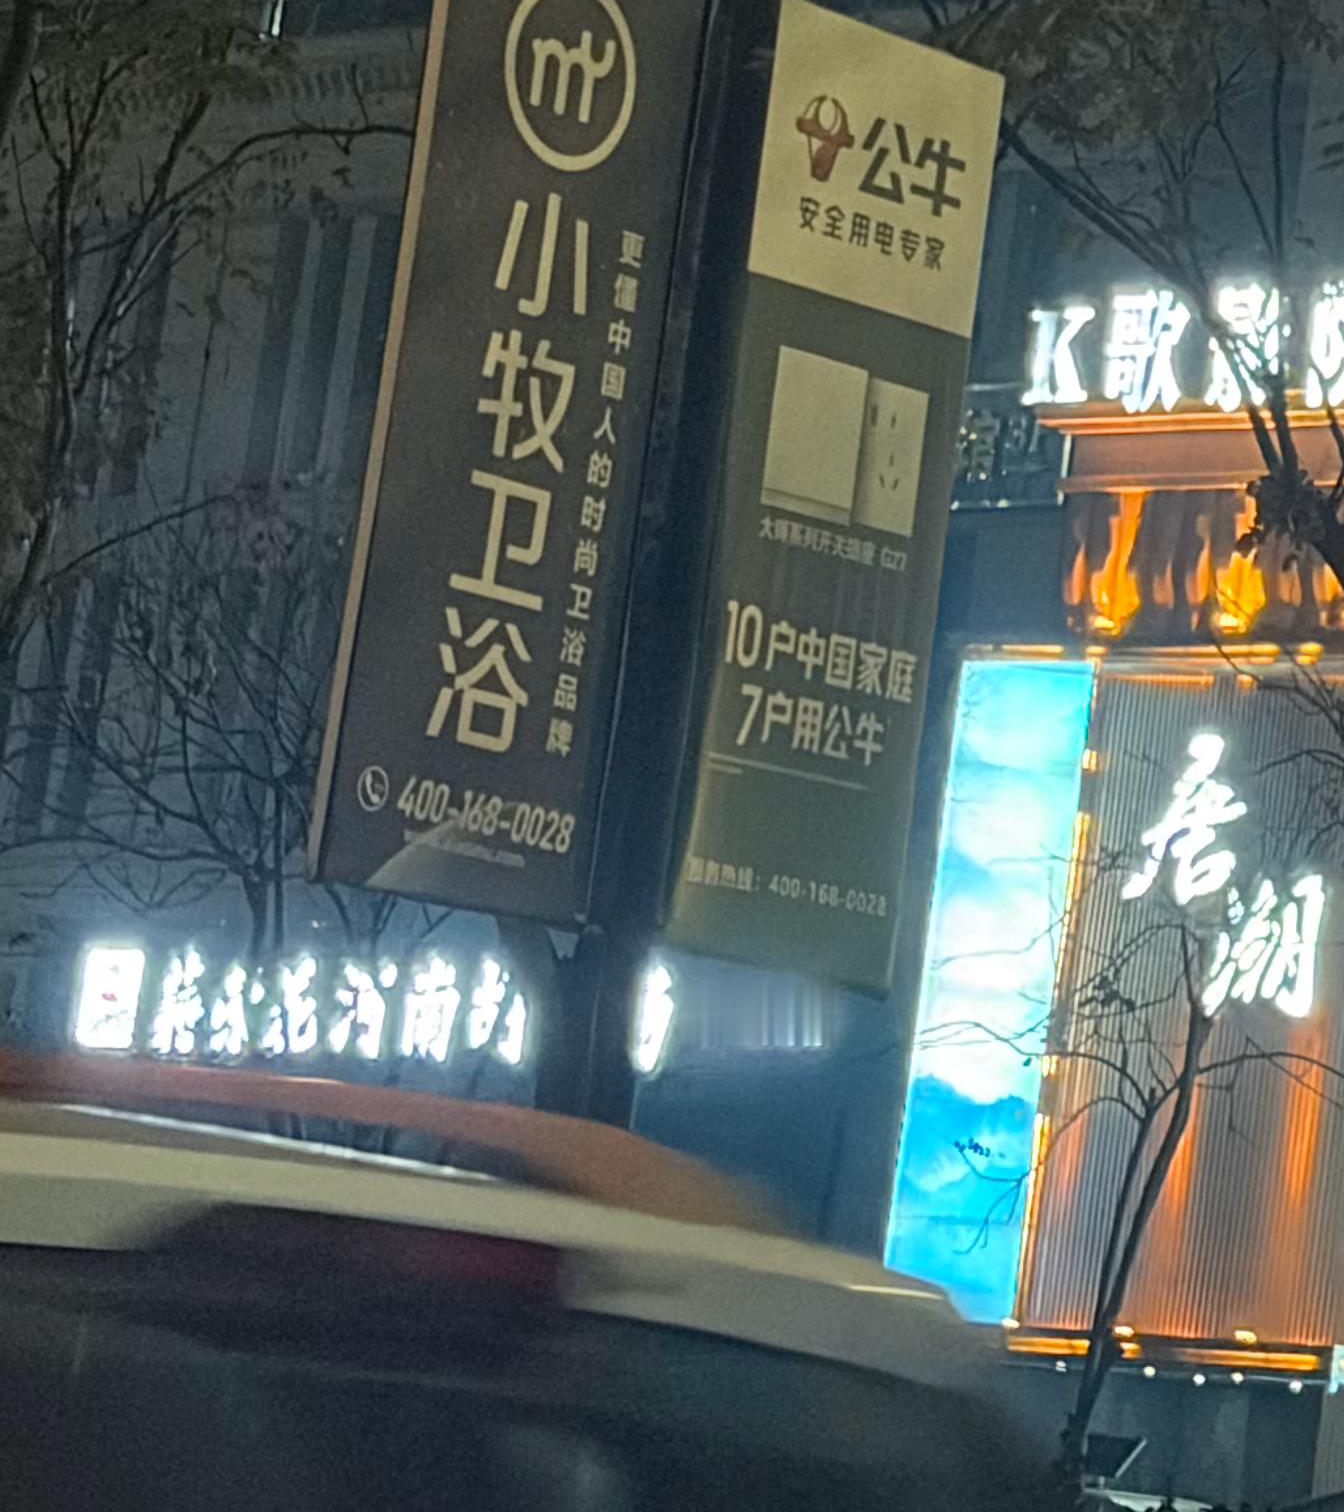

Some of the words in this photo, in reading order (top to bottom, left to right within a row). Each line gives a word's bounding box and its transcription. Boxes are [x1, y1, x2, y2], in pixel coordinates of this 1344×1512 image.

[857, 115, 967, 217] 公牛
[797, 196, 946, 272] 安全用电专家
[426, 191, 589, 754] 小牧卫浴
[724, 599, 918, 704] 10户中国家庭
[735, 683, 885, 767] 7户用公牛
[396, 775, 576, 855] 400-168-0028
